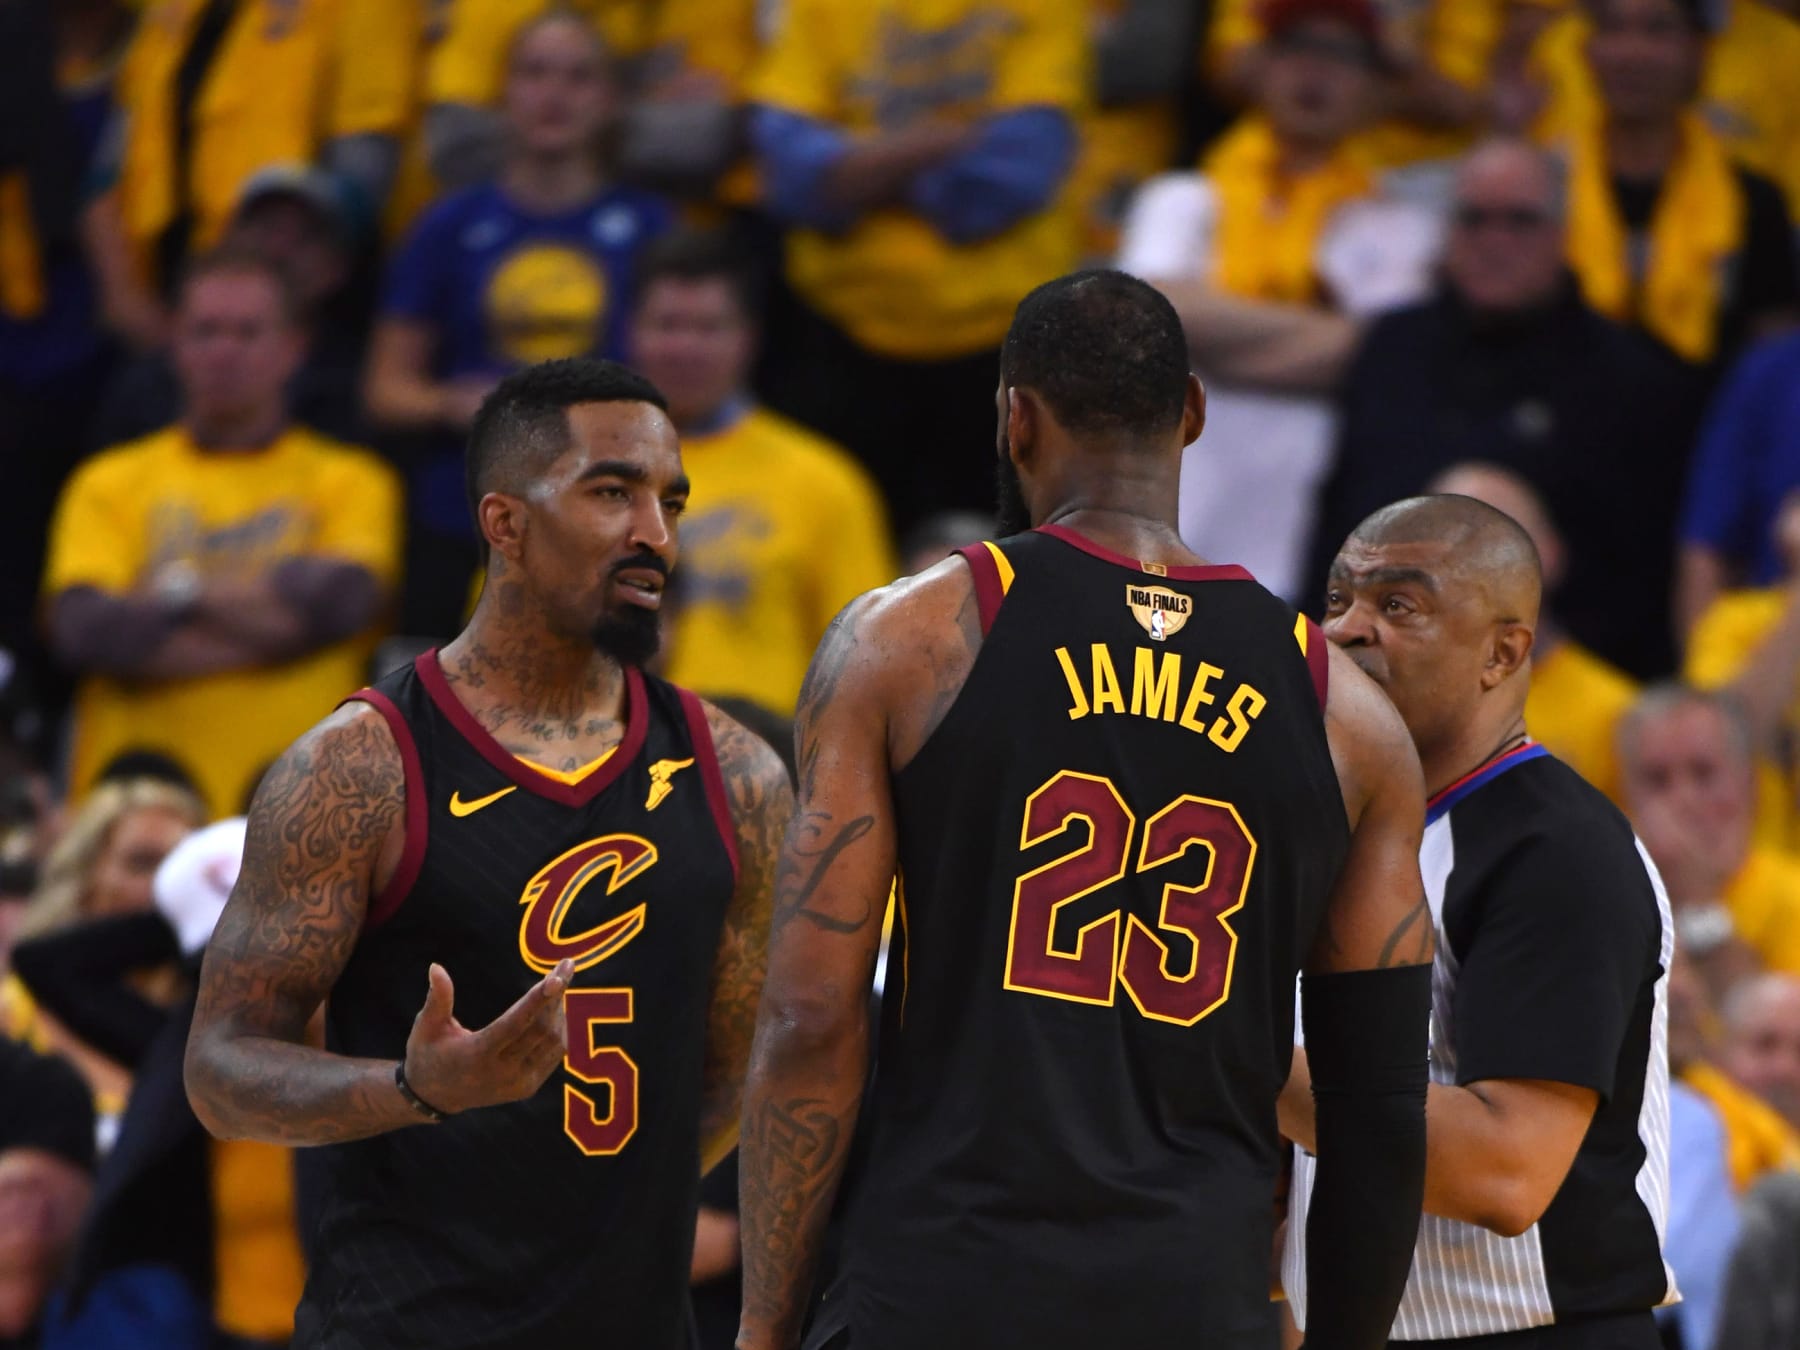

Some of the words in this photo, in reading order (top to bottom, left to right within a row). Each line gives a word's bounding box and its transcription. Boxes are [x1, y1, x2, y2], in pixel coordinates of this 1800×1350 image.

[1130, 589, 1151, 607] NBA
[1153, 593, 1188, 613] FINALS
[1055, 643, 1267, 753] JAMES
[518, 833, 658, 975] C
[1003, 769, 1257, 1027] 23
[564, 987, 639, 1156] 5
